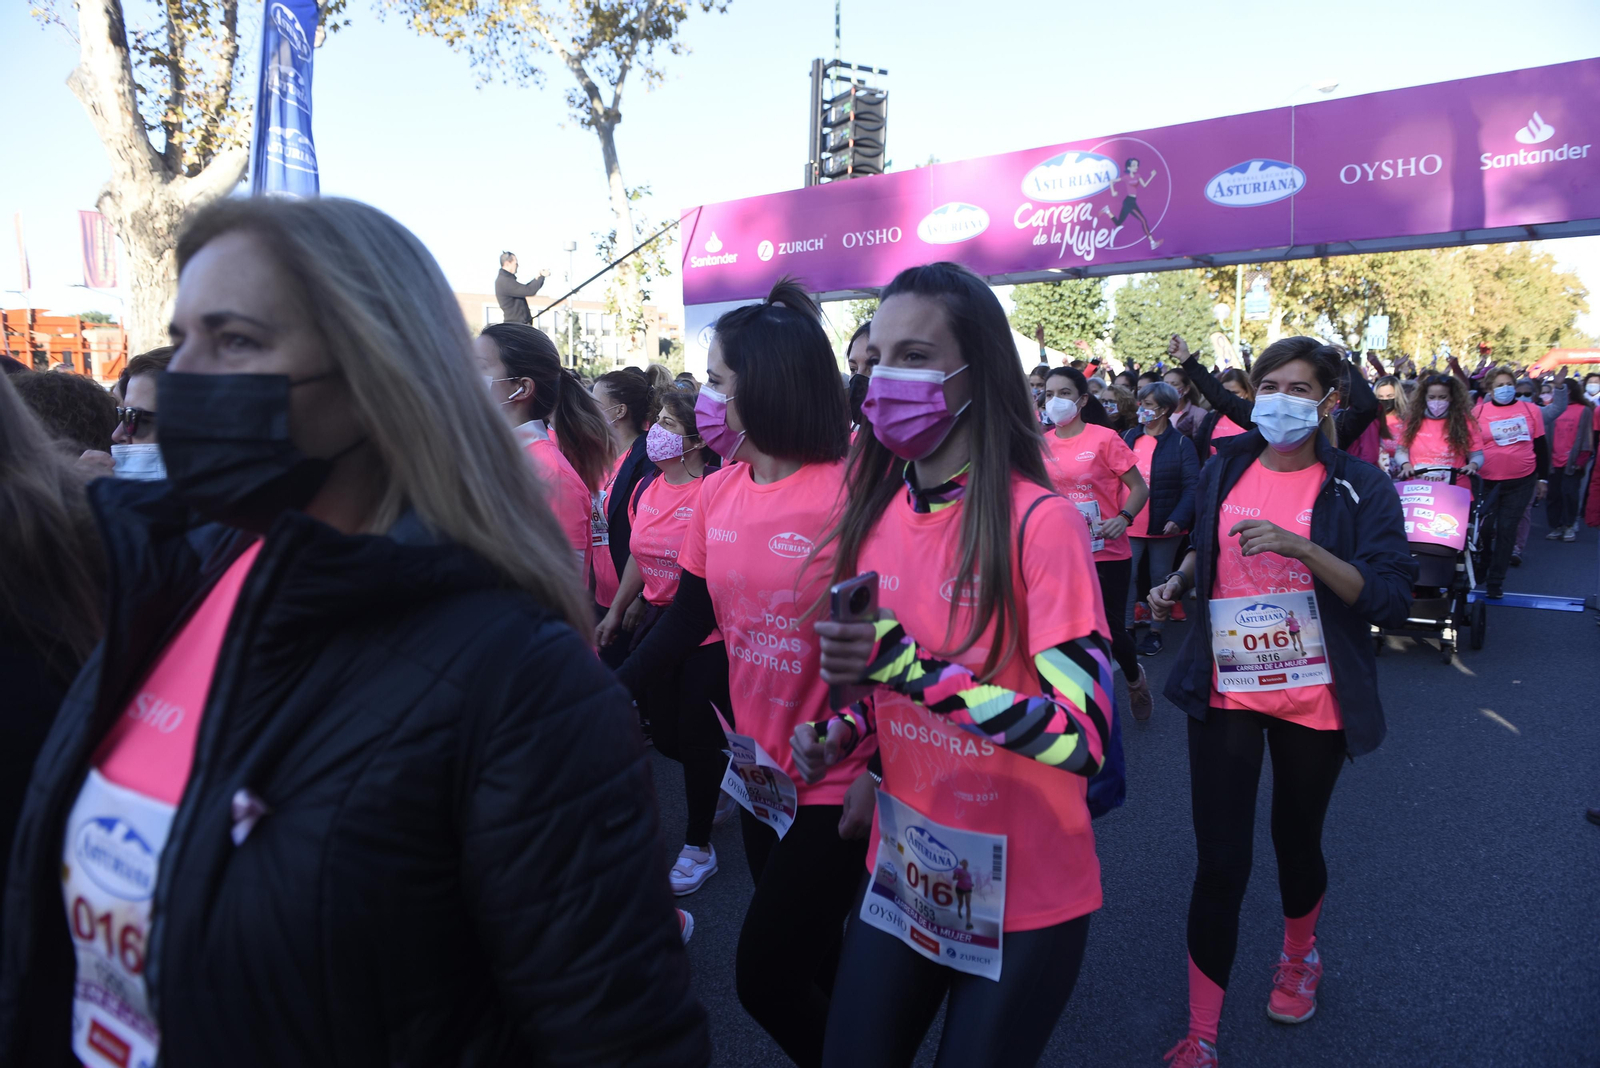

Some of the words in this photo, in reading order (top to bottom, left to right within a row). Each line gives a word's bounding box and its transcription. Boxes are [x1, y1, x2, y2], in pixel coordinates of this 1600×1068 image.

[1479, 143, 1592, 171] Santander
[1339, 153, 1443, 185] OYSHO
[1033, 169, 1112, 192] ASTURIANA
[1213, 177, 1297, 198] ASTURIANA
[1013, 202, 1093, 229] Carrera
[778, 238, 824, 255] ZURICH
[842, 226, 902, 248] OYSHO
[1032, 227, 1048, 246] de
[1050, 224, 1062, 244] la
[1058, 217, 1125, 261] Mujer
[690, 252, 738, 269] Santander
[1068, 491, 1094, 499] TODAS
[1221, 503, 1261, 518] OYSHO
[1416, 509, 1432, 518] LAS
[707, 527, 738, 543] OYSHO
[655, 558, 681, 569] TODA
[664, 549, 678, 559] PO
[642, 566, 681, 580] NOSOTRA
[1288, 571, 1312, 584] PO
[765, 613, 800, 632] POR
[1239, 612, 1285, 624] ASTURIANA
[747, 630, 802, 652] TODAS
[1243, 630, 1290, 651] 016
[729, 641, 802, 675] NOSOTRAS
[1236, 663, 1264, 672] CARRERA
[1264, 662, 1274, 670] DE
[1275, 661, 1284, 669] LA
[1285, 658, 1308, 668] MUJER
[1256, 652, 1281, 663] 1816
[1222, 677, 1255, 686] OYSHO
[1301, 671, 1324, 679] ZURICH
[890, 720, 996, 757] NOSOTRAS
[734, 752, 755, 761] RIANA
[738, 766, 767, 786] 16
[976, 791, 999, 802] 2021
[908, 831, 953, 868] ASTURIANA
[906, 861, 954, 907] 016
[894, 895, 919, 920] CARRERA
[918, 914, 928, 928] DE
[927, 920, 939, 934] LA
[939, 927, 973, 943] MUJER
[914, 897, 936, 921] 1353
[72, 896, 145, 976] 016
[869, 903, 908, 932] OYSHO
[959, 953, 991, 966] ZURICH
